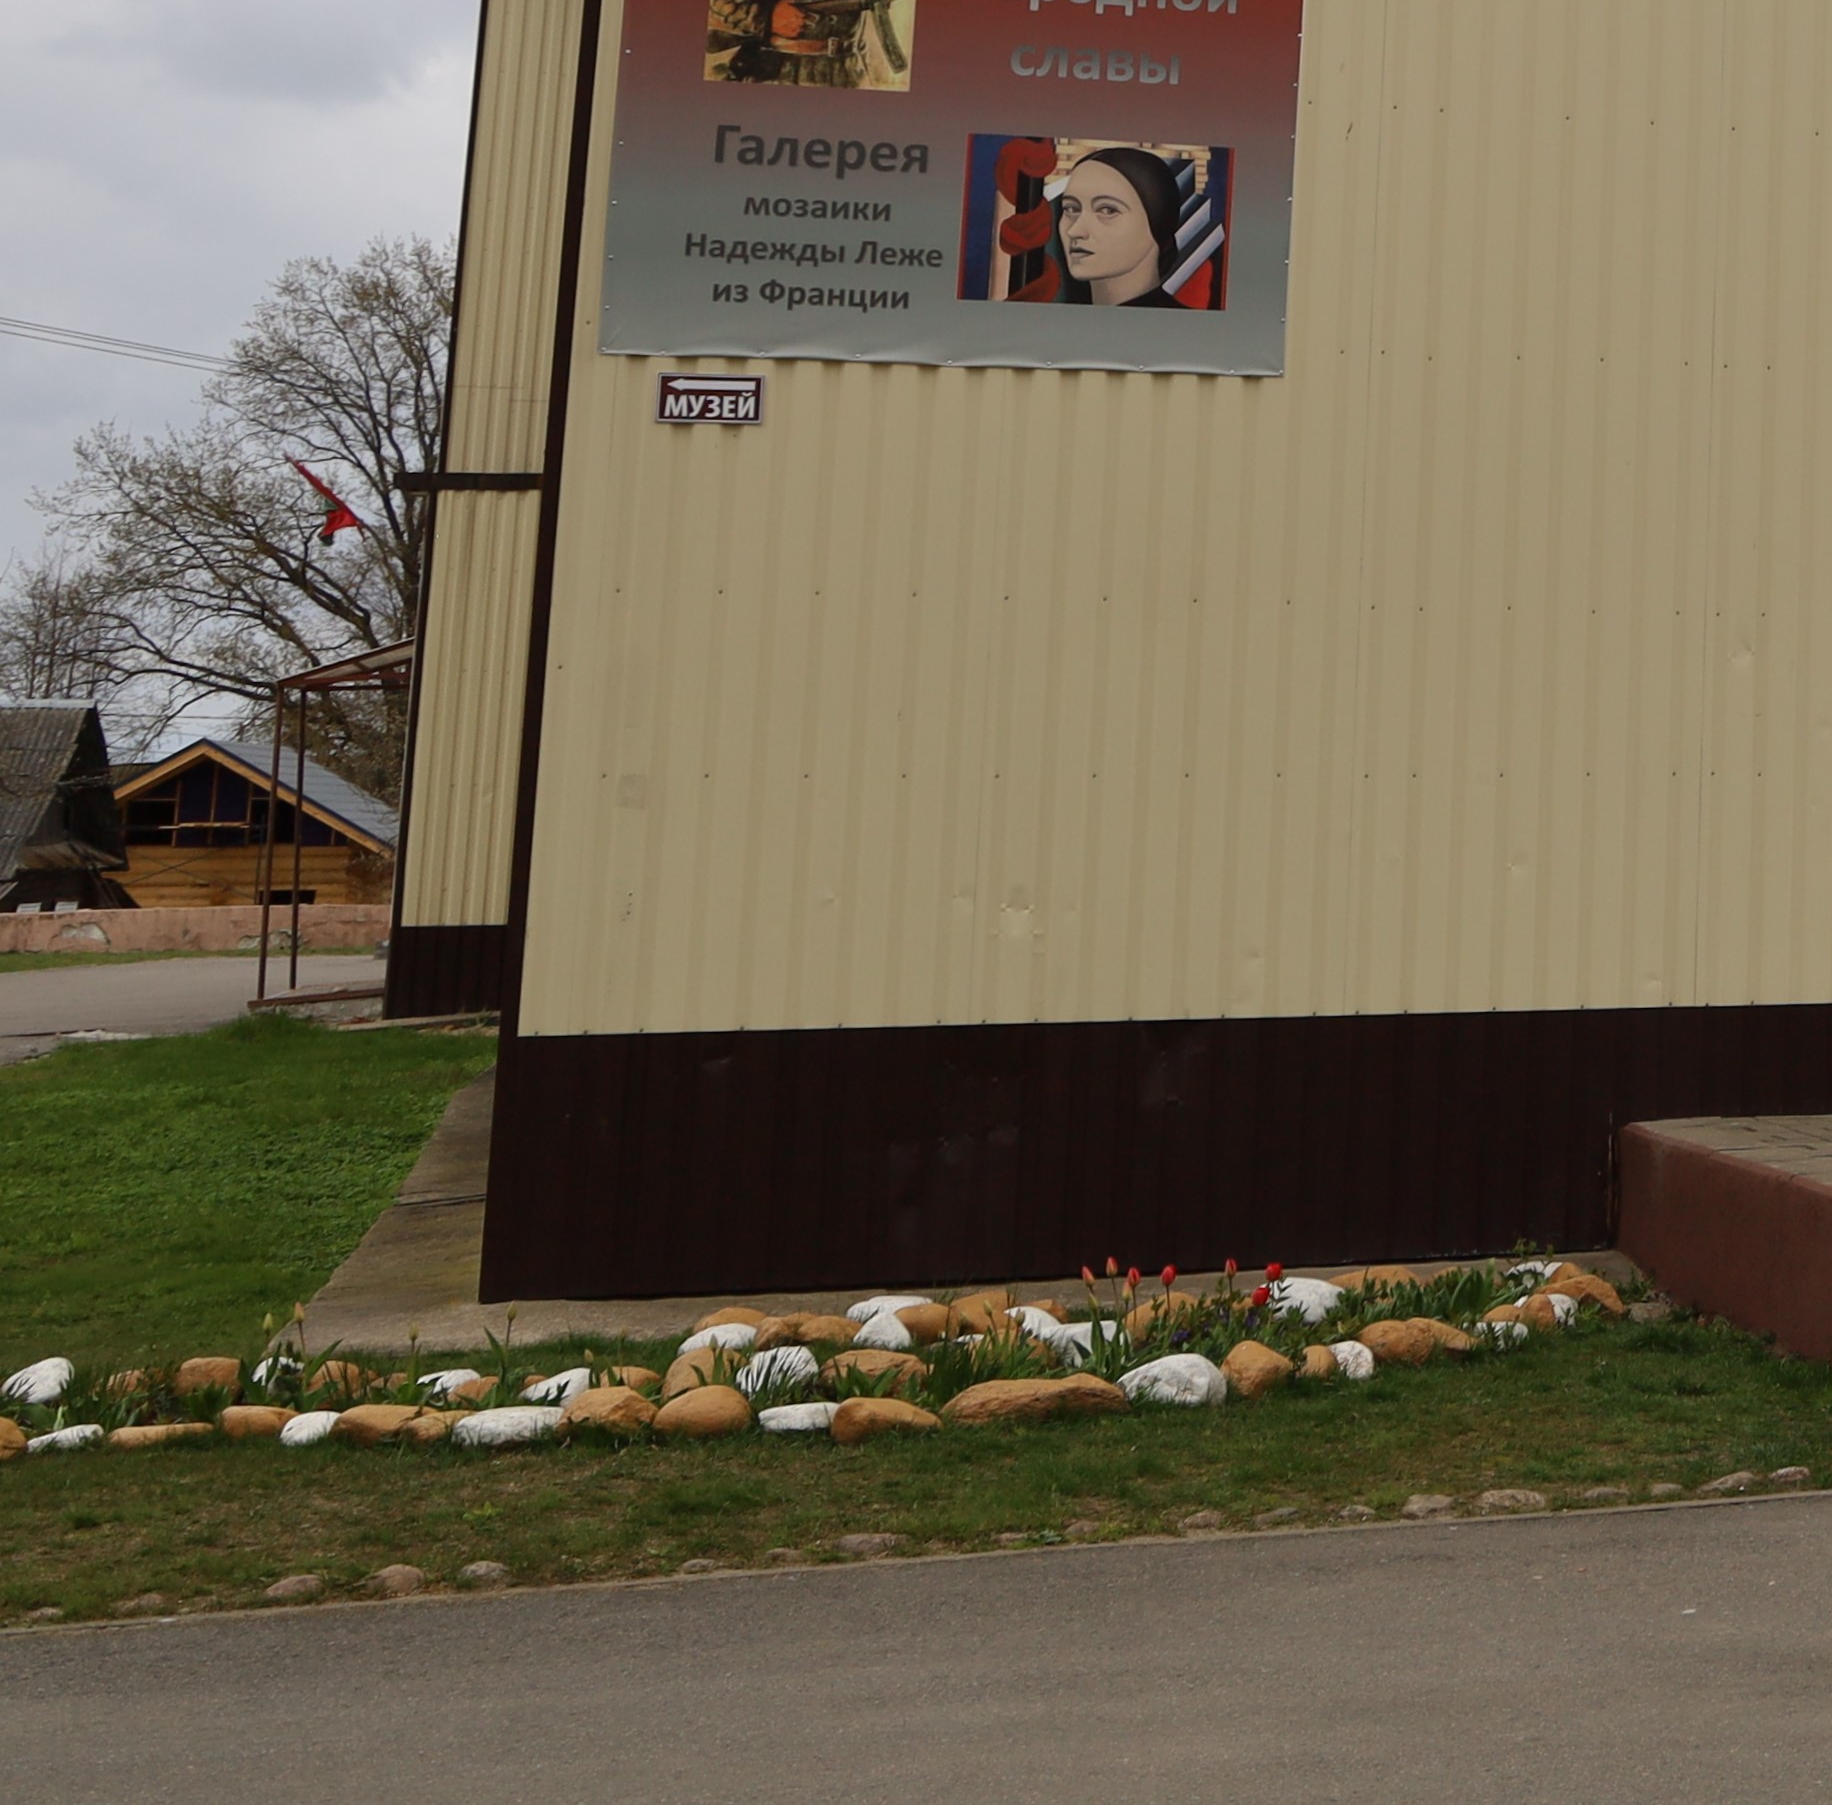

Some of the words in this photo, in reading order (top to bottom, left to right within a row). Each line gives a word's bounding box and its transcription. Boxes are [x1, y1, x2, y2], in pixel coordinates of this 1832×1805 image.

[1010, 44, 1180, 85] славы
[713, 124, 930, 179] Галерея
[743, 196, 892, 222] мозаики
[684, 232, 846, 267] Надежды
[854, 241, 944, 268] Леже
[712, 282, 749, 303] из
[758, 279, 911, 313] Франции
[663, 391, 756, 419] МУЗЕЙ
